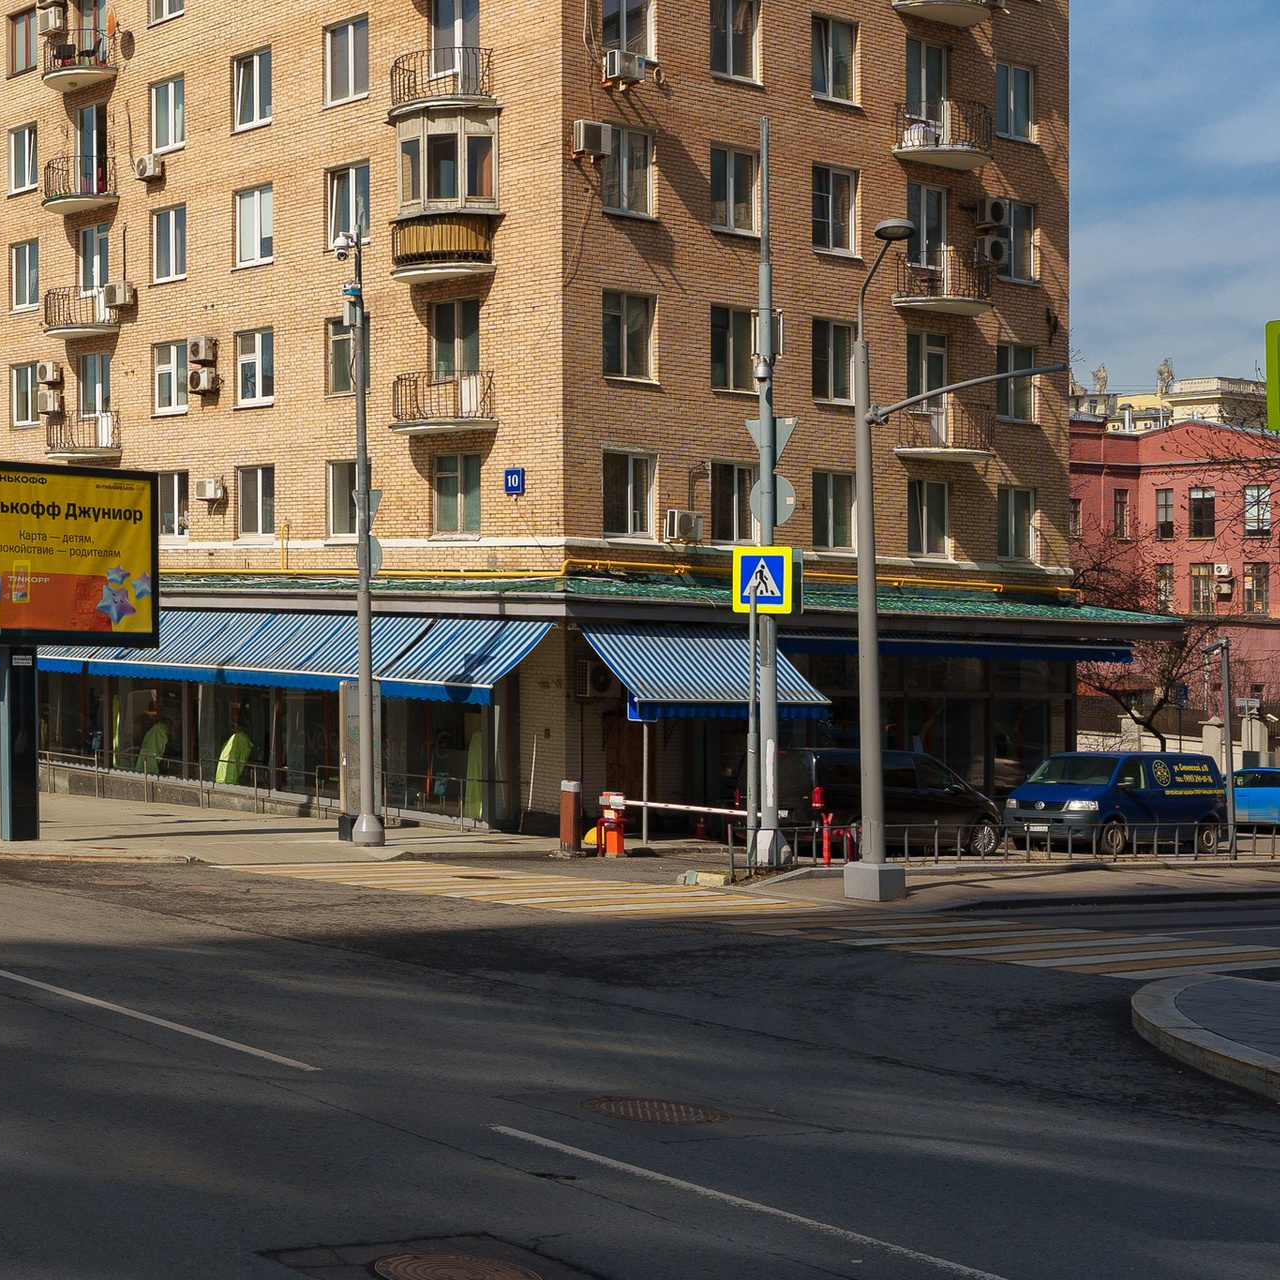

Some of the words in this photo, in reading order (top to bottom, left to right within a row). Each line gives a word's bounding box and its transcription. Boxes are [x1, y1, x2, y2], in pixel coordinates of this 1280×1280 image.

[507, 474, 519, 487] 10
[64, 502, 144, 524] Джуниор
[19, 530, 47, 543] Карта
[62, 533, 95, 545] детям,
[69, 547, 121, 558] родителям
[8, 575, 51, 584] TINKOFF
